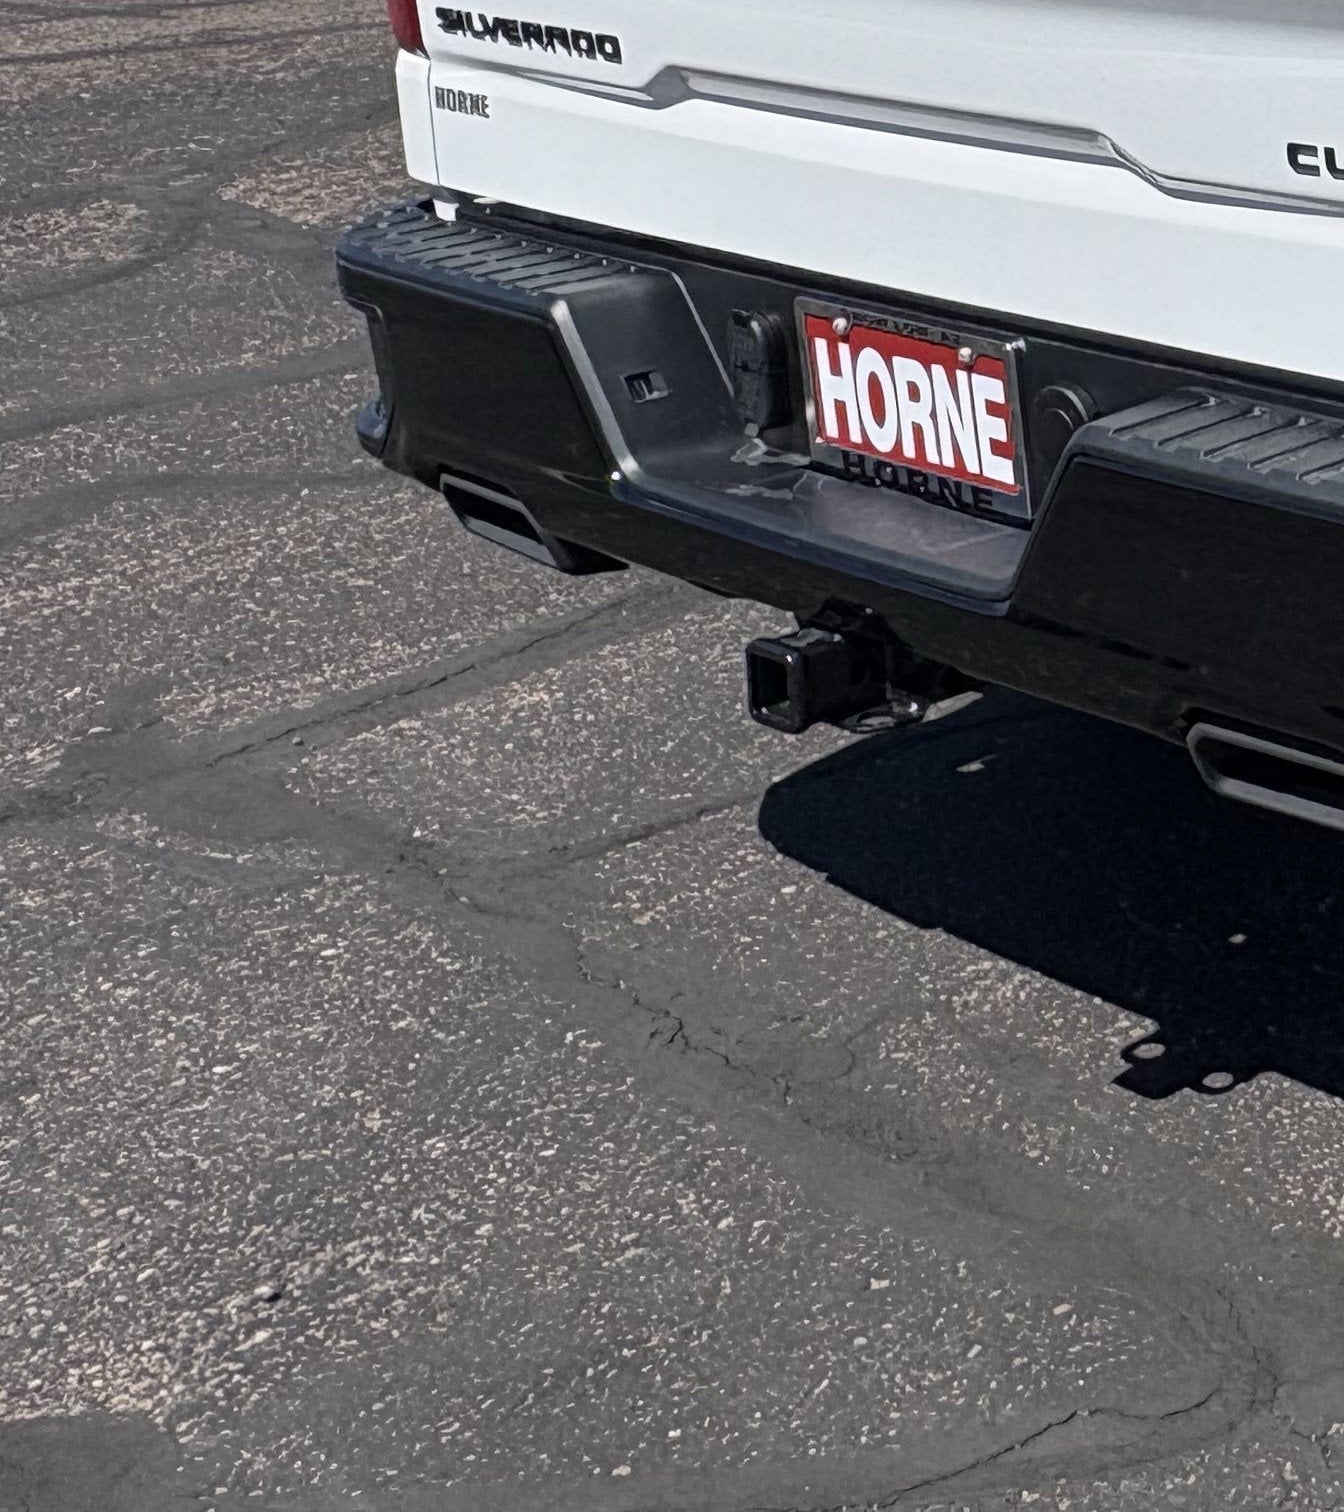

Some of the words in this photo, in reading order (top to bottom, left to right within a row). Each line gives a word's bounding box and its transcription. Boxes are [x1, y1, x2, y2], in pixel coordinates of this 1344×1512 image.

[435, 6, 622, 65] SILVERADO
[434, 86, 490, 119] HORNE
[813, 337, 1015, 485] HORNE
[841, 450, 994, 509] HORNE
